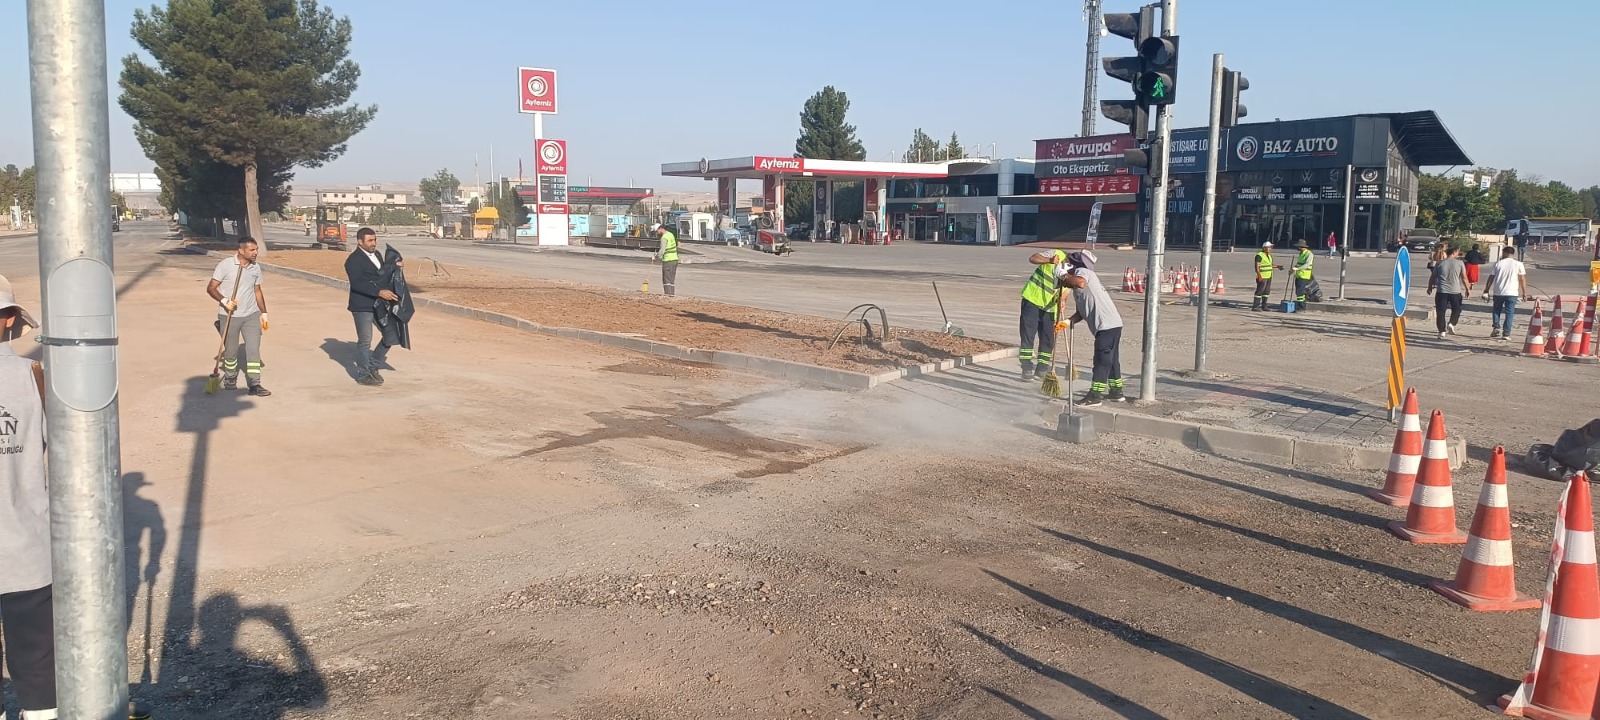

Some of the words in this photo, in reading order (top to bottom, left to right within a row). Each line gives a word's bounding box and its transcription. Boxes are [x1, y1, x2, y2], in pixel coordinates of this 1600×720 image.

[525, 98, 552, 107] Aytemiz
[1066, 141, 1112, 158] Avrupa
[1264, 140, 1291, 154] BAZ
[1294, 137, 1338, 152] AUTO
[759, 158, 800, 170] Aytemiz
[1052, 164, 1068, 175] Oto
[1069, 161, 1110, 177] Ekspertiz
